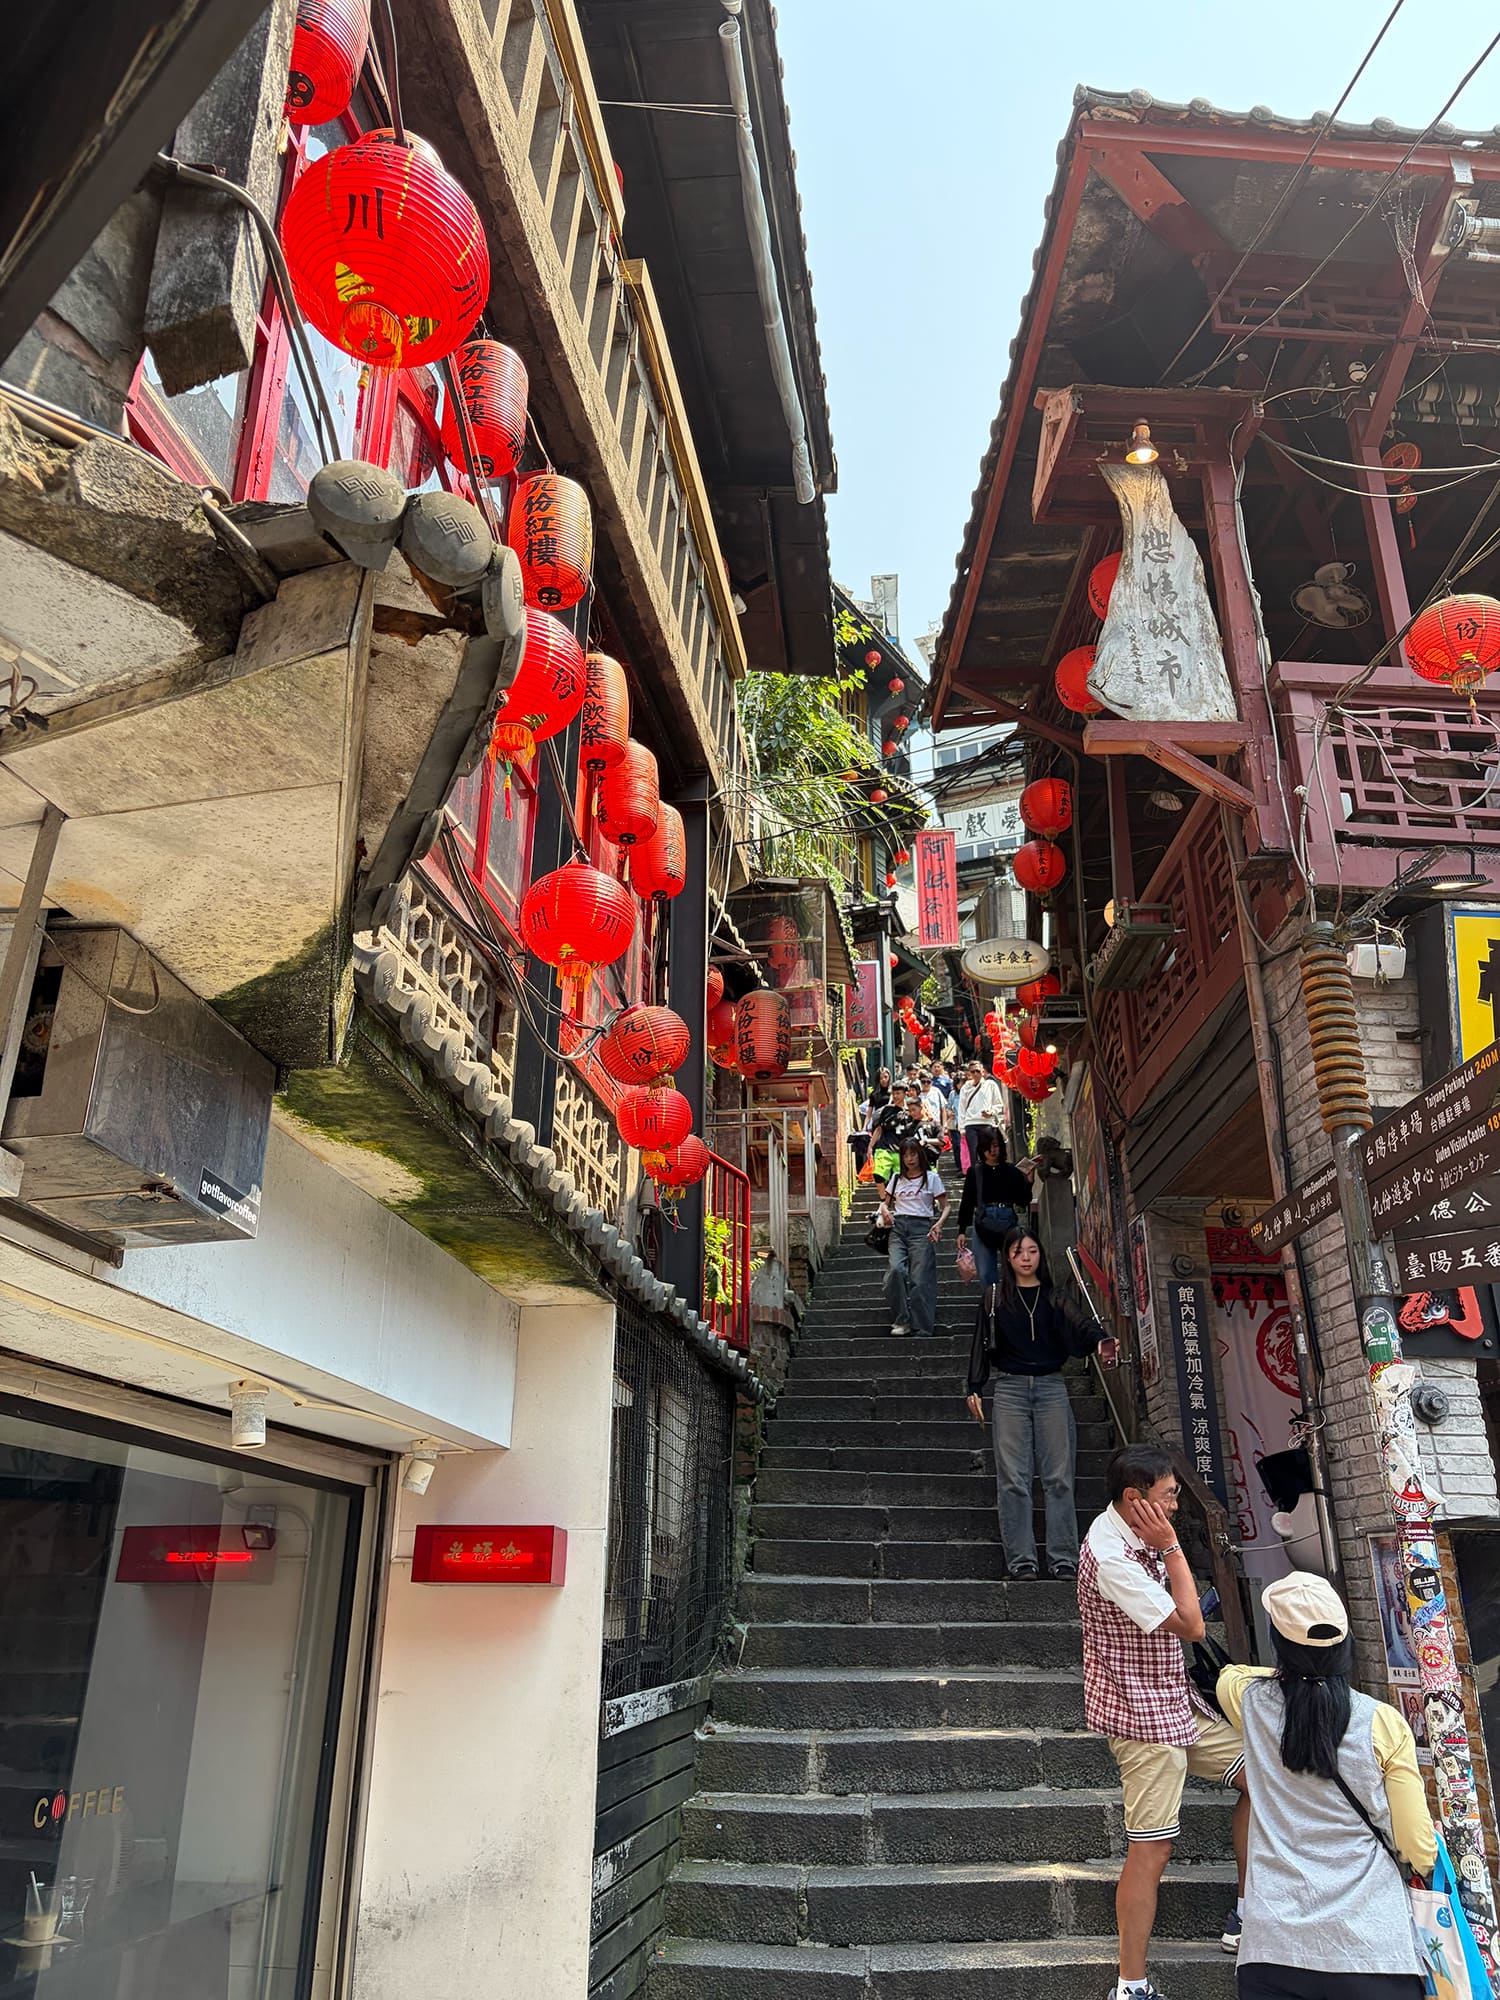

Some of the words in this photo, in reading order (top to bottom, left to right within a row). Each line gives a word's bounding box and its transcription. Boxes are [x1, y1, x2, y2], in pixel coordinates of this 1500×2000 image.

[523, 477, 561, 568] 九份紅樓
[1141, 528, 1191, 699] 悲情城市
[921, 836, 949, 940] 阿妹茶樓
[623, 1021, 654, 1068] 九份
[737, 1000, 759, 1065] 九份紅樓
[1444, 1074, 1466, 1096] Parking
[1464, 1067, 1475, 1083] Lot
[1475, 1049, 1499, 1075] 240M
[1366, 1110, 1423, 1166] 台陽停車場
[1449, 1136, 1469, 1154] Visitor
[1467, 1124, 1486, 1144] Center
[201, 1180, 257, 1225] gotflavorcoffee
